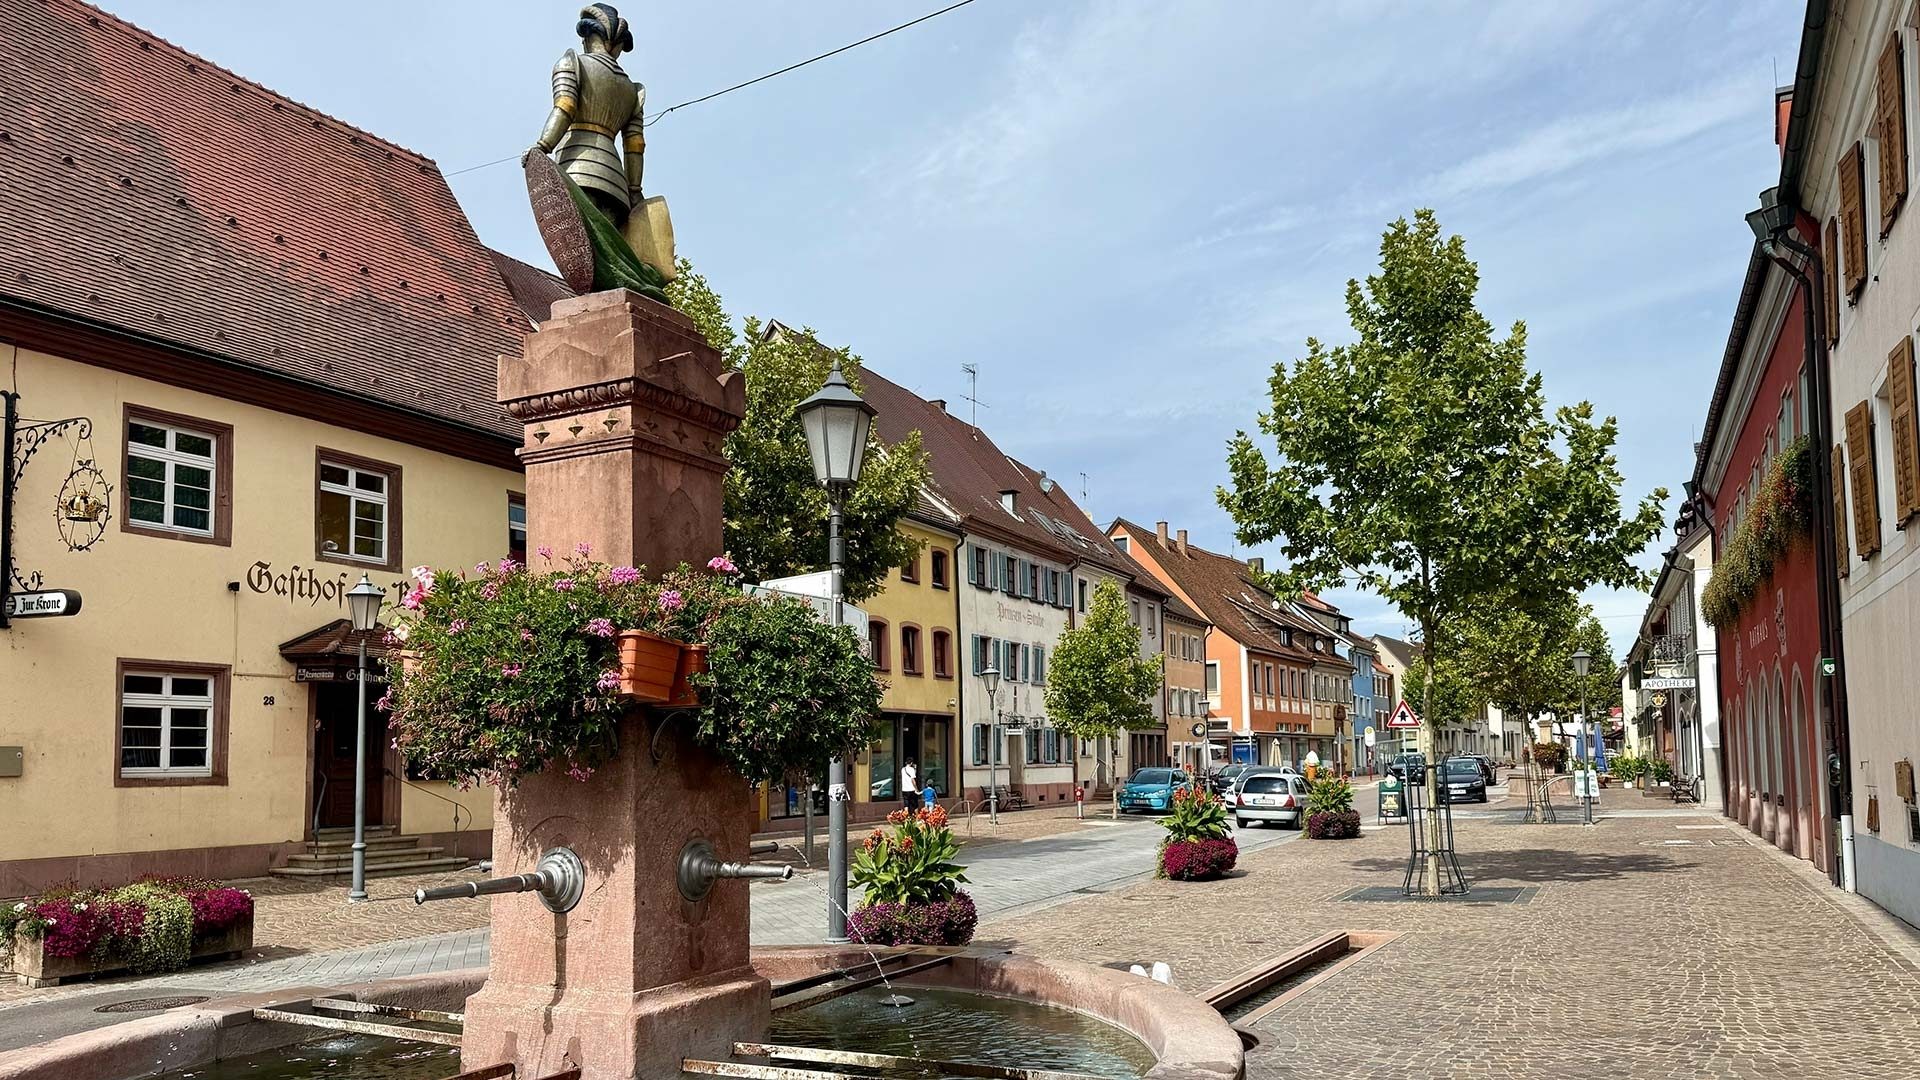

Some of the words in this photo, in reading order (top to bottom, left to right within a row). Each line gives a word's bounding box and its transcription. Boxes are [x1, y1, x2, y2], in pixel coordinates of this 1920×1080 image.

[247, 560, 348, 609] Gasthof
[36, 596, 61, 610] Krone
[1645, 680, 1694, 688] APOTHEKE
[263, 696, 275, 706] 28
